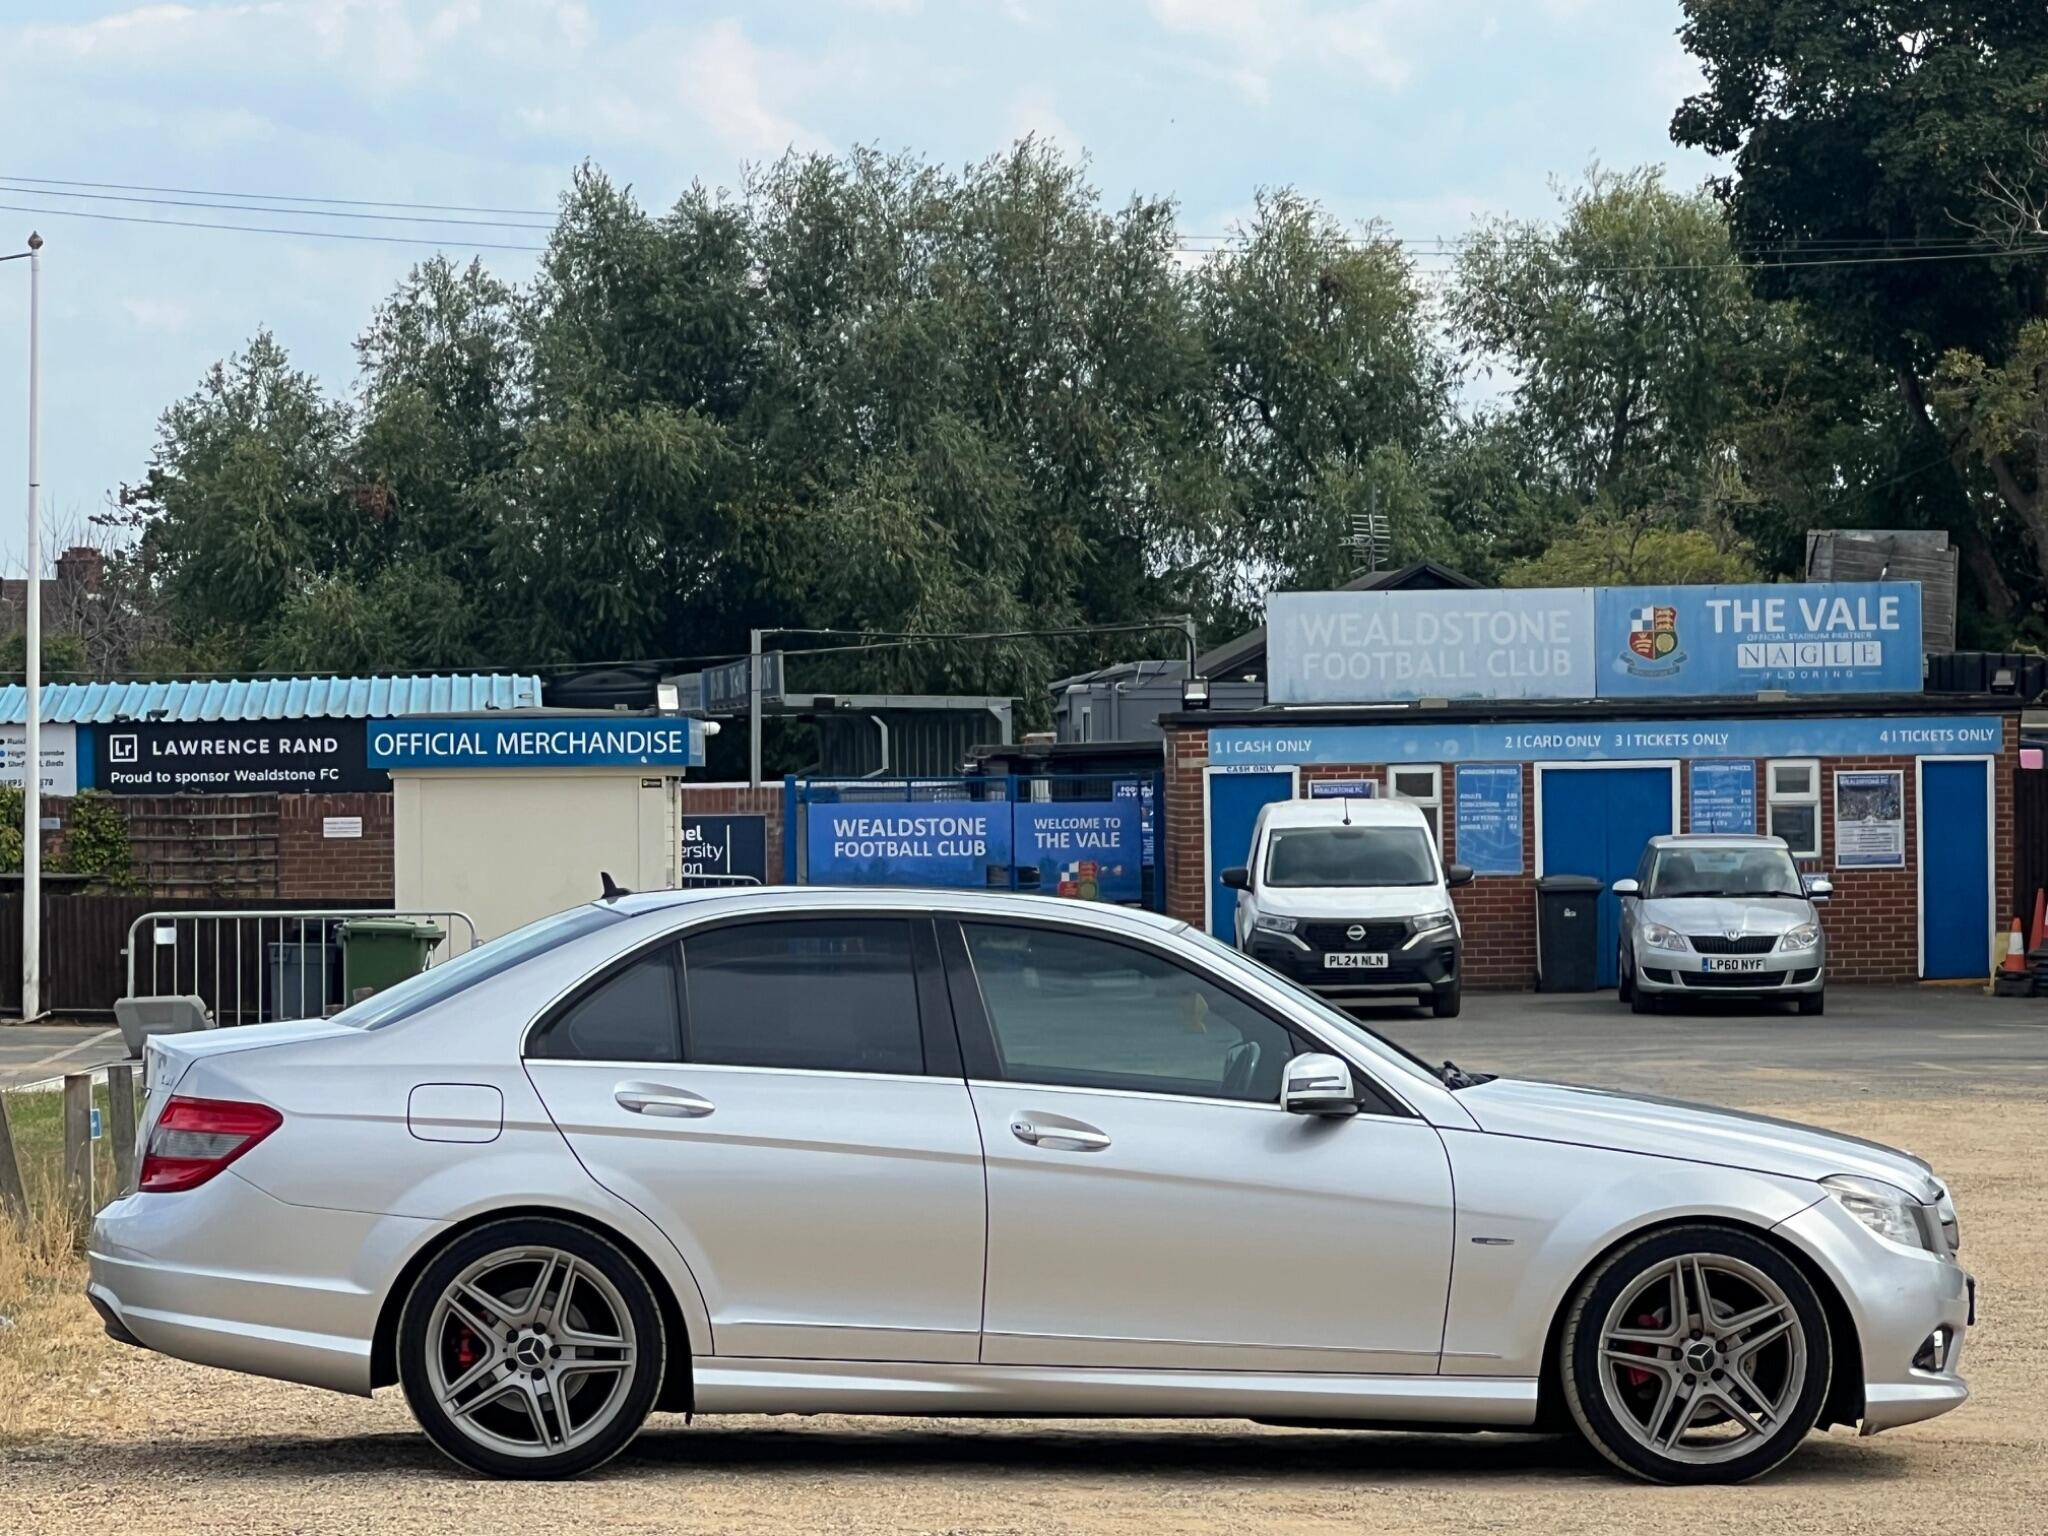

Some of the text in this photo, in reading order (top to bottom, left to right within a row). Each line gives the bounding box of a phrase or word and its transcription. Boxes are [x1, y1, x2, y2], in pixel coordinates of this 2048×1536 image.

[1706, 596, 1900, 633] THE VALE
[1301, 610, 1572, 647] WEALDSTONE
[1742, 644, 1878, 666] NAGLE
[1303, 649, 1571, 680] FOOTBALL CLUB
[374, 731, 683, 756] OFFICIAL MERCHANDISE
[1505, 736, 1513, 748] 2
[1523, 735, 1563, 748] CARD
[1565, 735, 1601, 747] ONLY
[1615, 735, 1622, 747] 3
[1634, 734, 1688, 746] TICKETS
[1693, 733, 1728, 745] ONLY
[1880, 730, 1888, 742] 4
[1900, 730, 1953, 742] TICKETS
[1958, 729, 1994, 741] ONLY
[152, 738, 338, 756] LAWRENCE RAND
[1215, 743, 1222, 754] 1
[1235, 741, 1271, 753] CASH
[1276, 740, 1312, 752] ONLY
[111, 768, 339, 785] Proud to sponsor Wealdstone FC
[834, 818, 986, 837] WEALDSTONE
[1034, 817, 1121, 829] WELCOME TO
[834, 840, 986, 857] FOOTBALL CLUB
[1035, 832, 1120, 848] THE VALE
[1329, 956, 1384, 966] PL24 NLN
[1710, 959, 1763, 970] LP60 NYF
